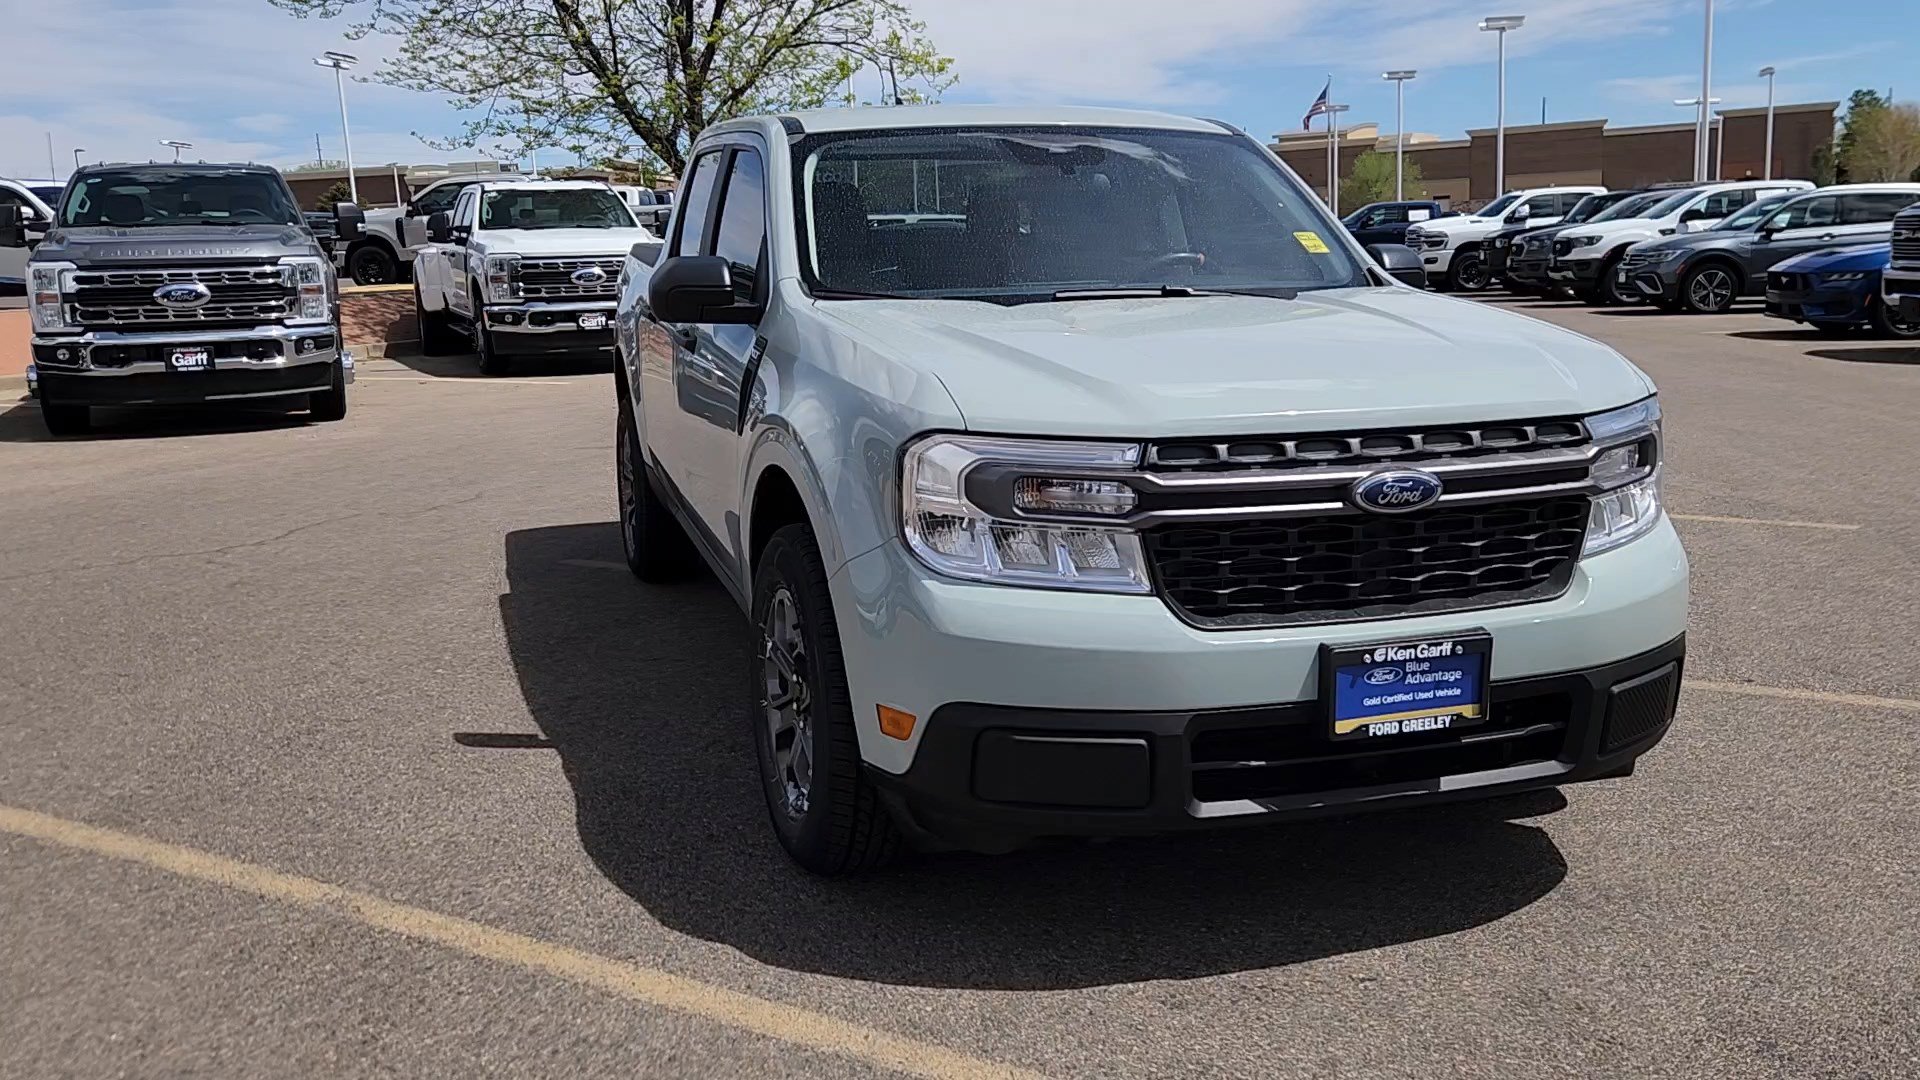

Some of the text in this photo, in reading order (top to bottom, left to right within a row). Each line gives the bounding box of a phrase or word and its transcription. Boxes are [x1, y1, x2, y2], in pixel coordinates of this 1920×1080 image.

[171, 352, 208, 366] Garff
[1378, 481, 1424, 504] Ford
[1387, 643, 1453, 661] Ken Garff
[1405, 661, 1430, 672] Blue
[1370, 670, 1396, 683] Ford
[1404, 670, 1462, 685] Advantage
[1363, 687, 1461, 706] Gold Certified Used Vehicle
[1369, 716, 1451, 737] FORD GREELEY
